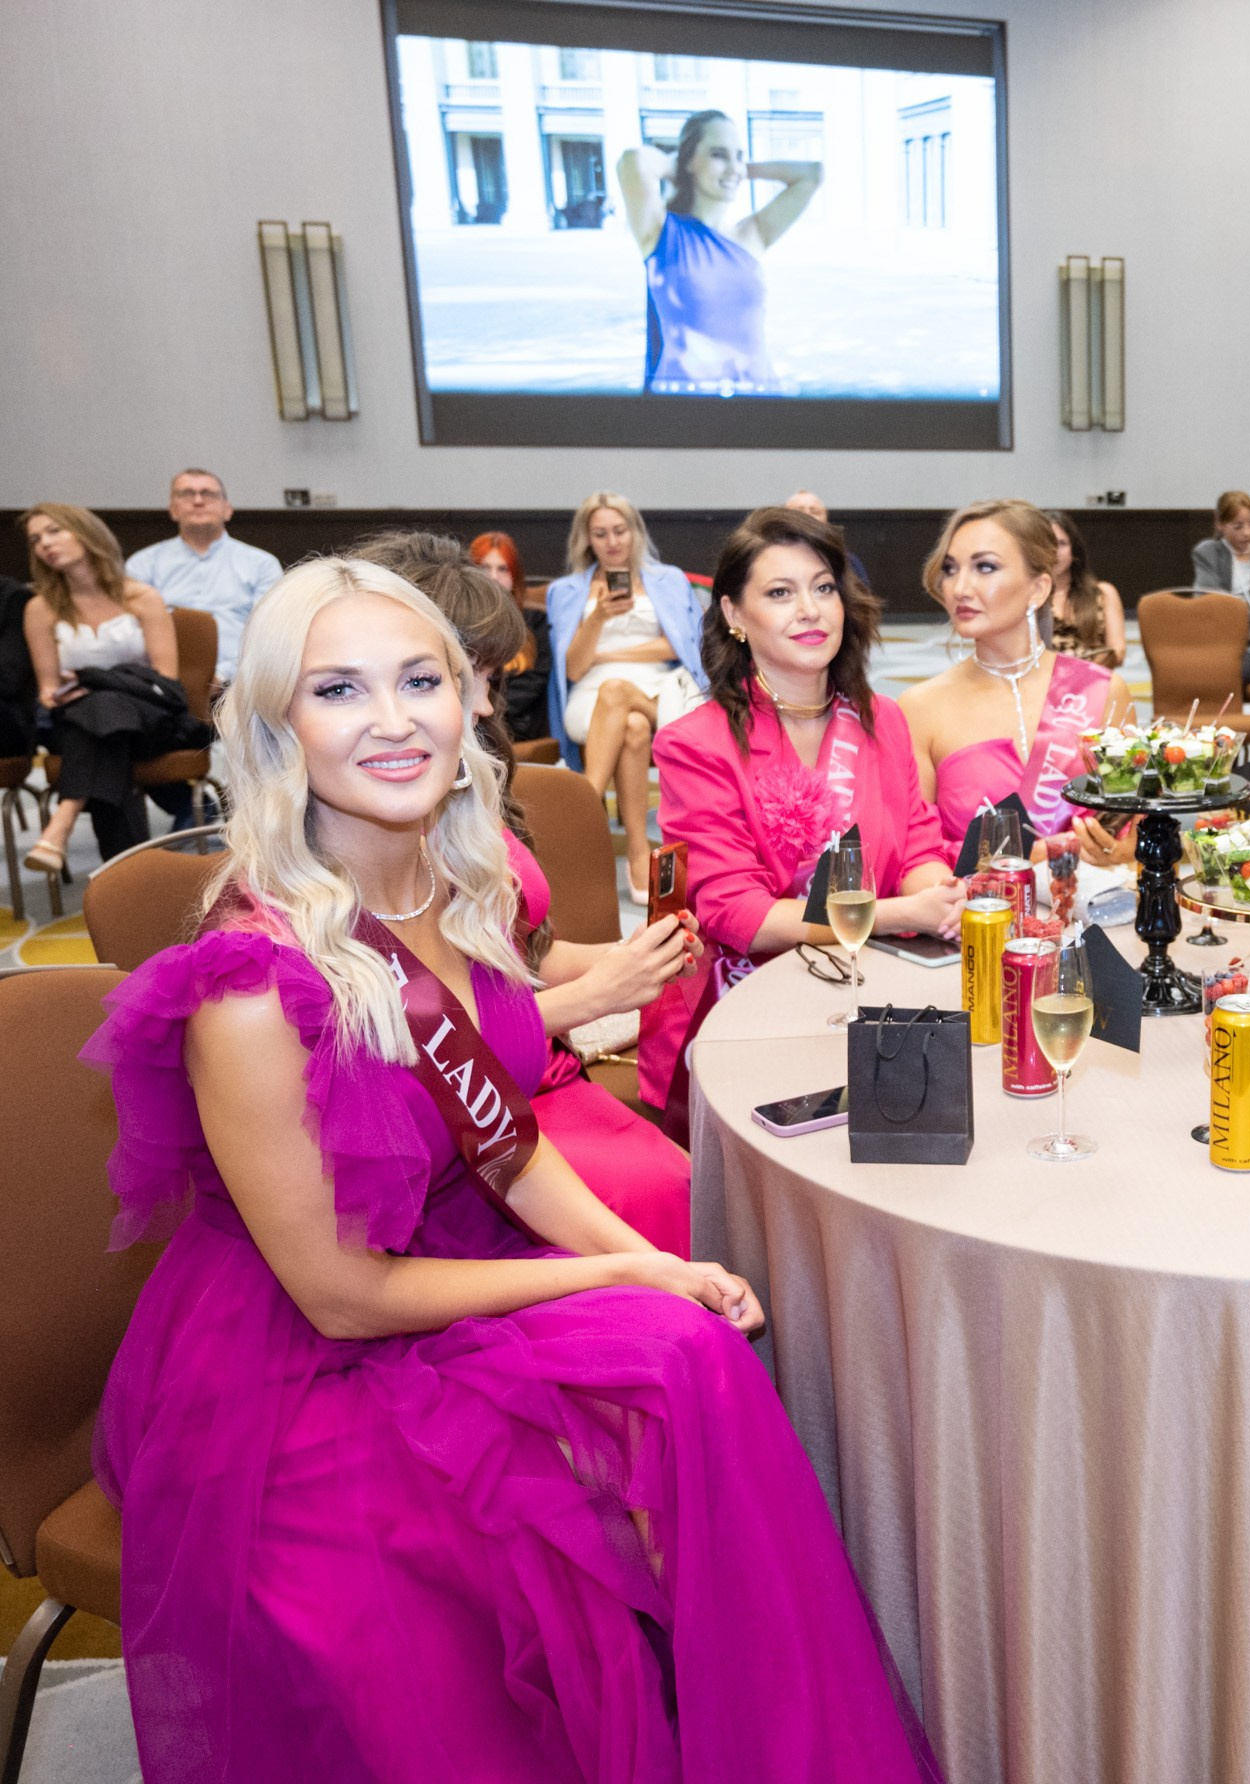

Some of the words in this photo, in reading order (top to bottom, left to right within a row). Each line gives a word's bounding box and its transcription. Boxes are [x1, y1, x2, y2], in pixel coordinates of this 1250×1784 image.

[1027, 742, 1077, 834] LADY
[1003, 965, 1019, 1079] MILANO
[421, 1013, 517, 1156] LADY
[1212, 1026, 1232, 1150] MILANO
